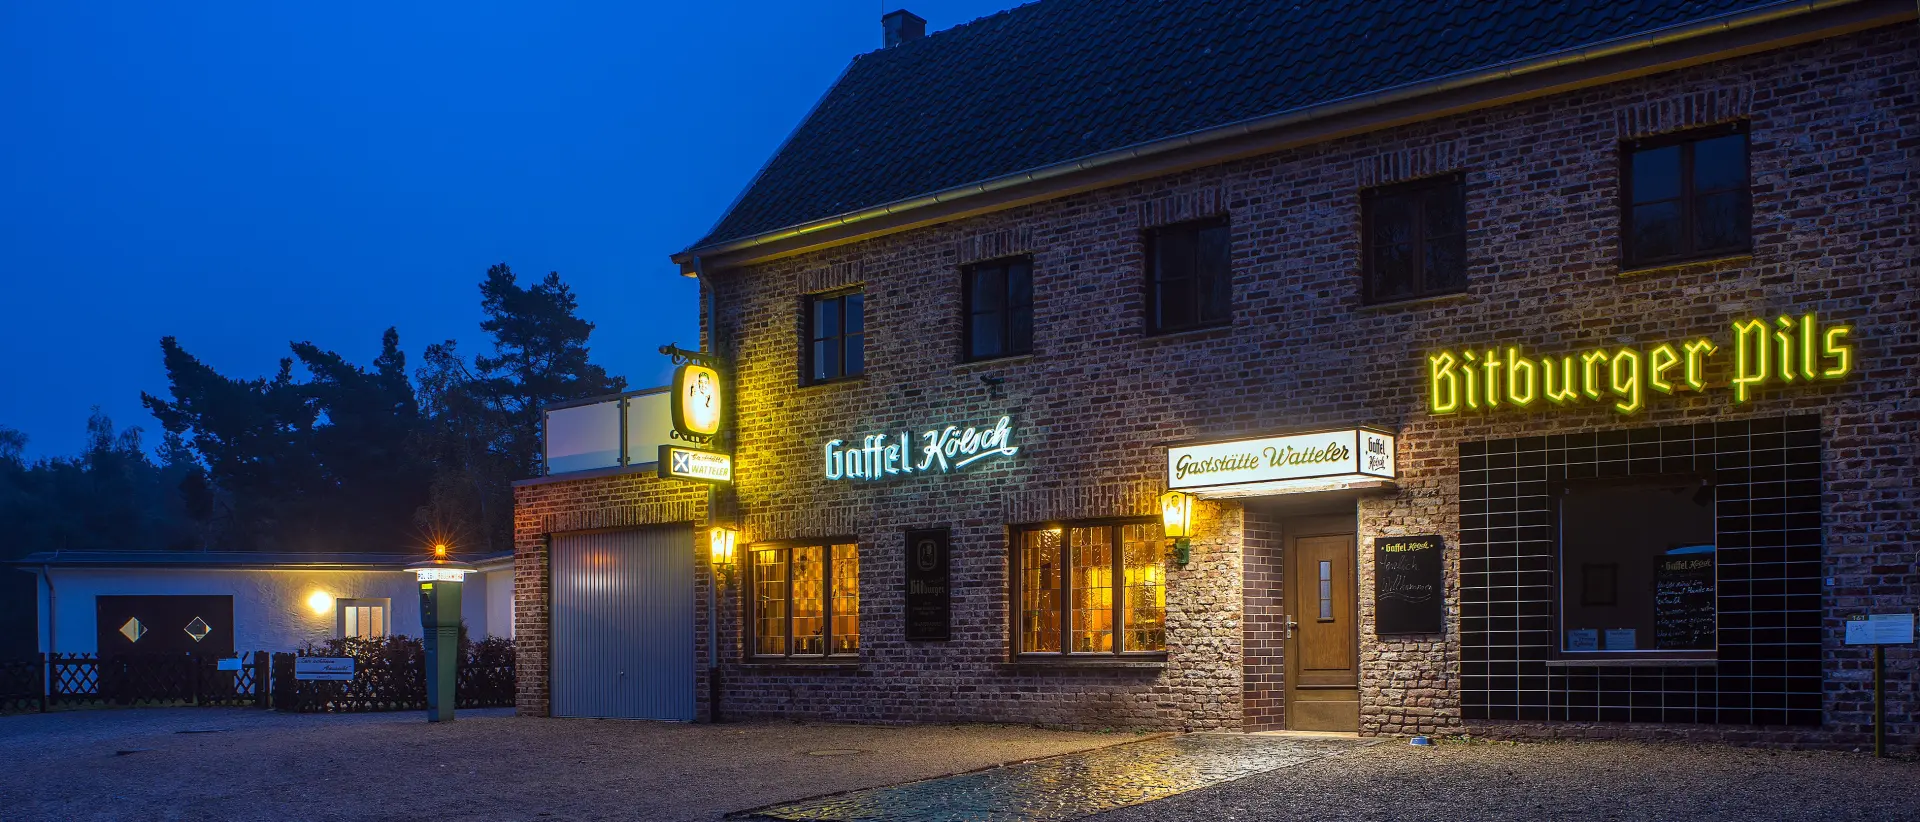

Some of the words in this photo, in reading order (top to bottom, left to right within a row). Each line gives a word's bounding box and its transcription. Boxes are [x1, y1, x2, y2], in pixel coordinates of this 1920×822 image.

[1429, 337, 1720, 415] Bitburger
[1731, 312, 1854, 405] Pils
[825, 430, 914, 481] Gaffel
[917, 416, 1019, 474] Kölsch
[1368, 436, 1386, 456] Gaffel
[1176, 453, 1260, 480] Gaststätte
[1263, 441, 1350, 467] Watteler
[691, 464, 730, 477] WATTELER
[1385, 543, 1407, 553] Gaffel
[1665, 560, 1688, 571] Gaffel
[909, 579, 945, 596] Bitburger
